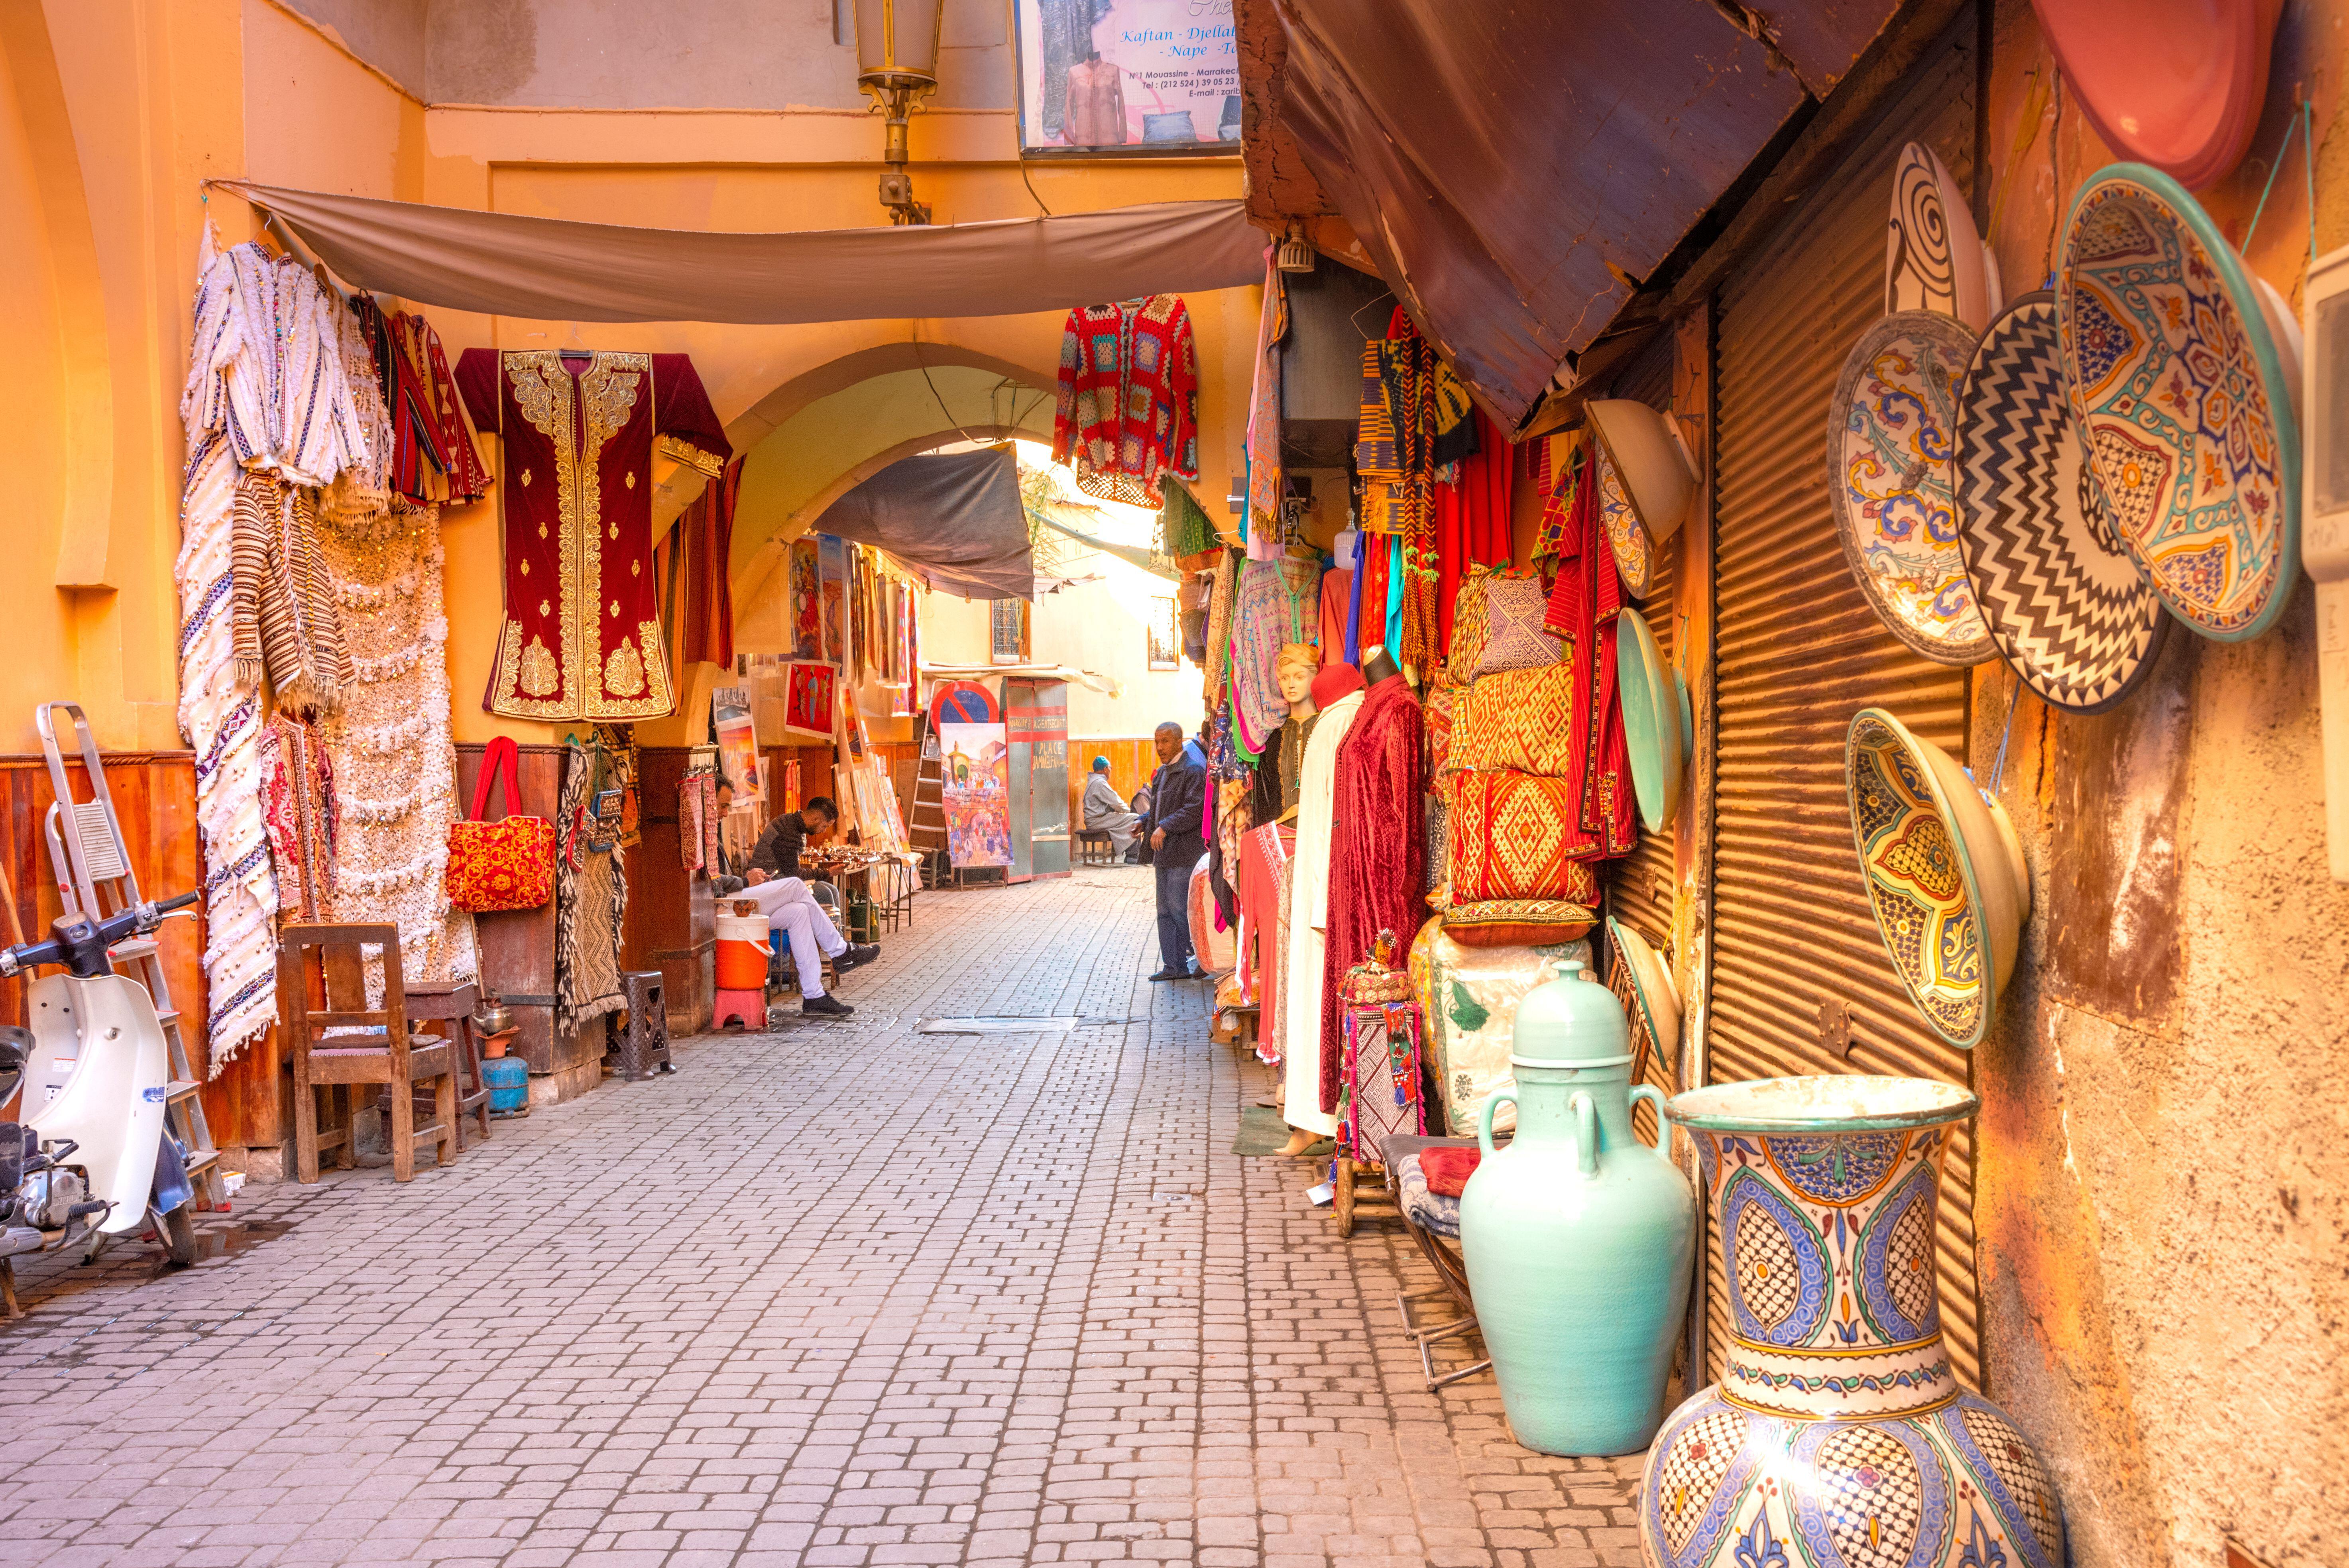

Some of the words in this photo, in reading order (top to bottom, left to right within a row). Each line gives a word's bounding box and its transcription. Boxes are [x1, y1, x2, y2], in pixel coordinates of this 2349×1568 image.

[1120, 28, 1174, 46] Kaftan
[1168, 45, 1207, 60] Nape
[1146, 70, 1189, 79] Mouassine
[1161, 81, 1177, 90] (212
[1189, 88, 1214, 97] E-mail
[1039, 742, 1062, 755] PLACE
